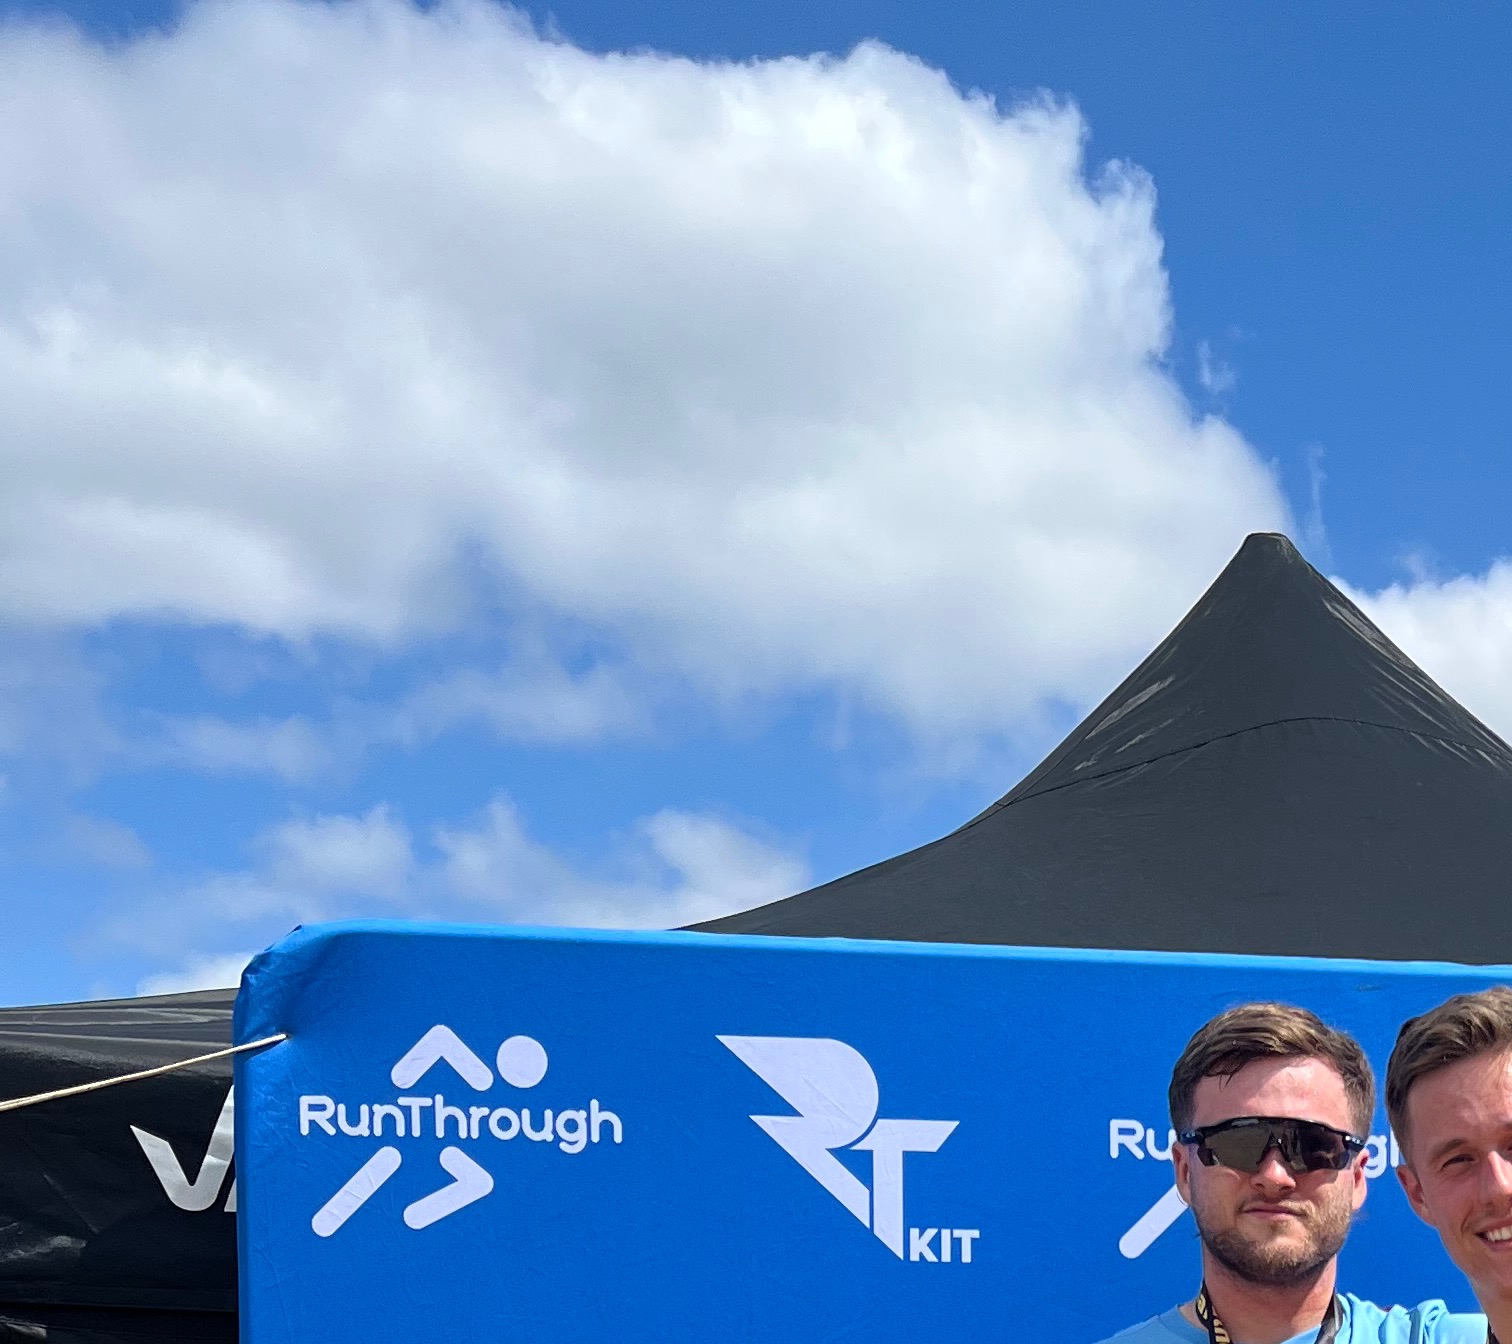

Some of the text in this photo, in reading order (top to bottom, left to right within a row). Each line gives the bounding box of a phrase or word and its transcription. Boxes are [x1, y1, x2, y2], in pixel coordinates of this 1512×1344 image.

[129, 1084, 238, 1212] V
[300, 1094, 622, 1153] RunThrough
[910, 1228, 979, 1263] KIT
